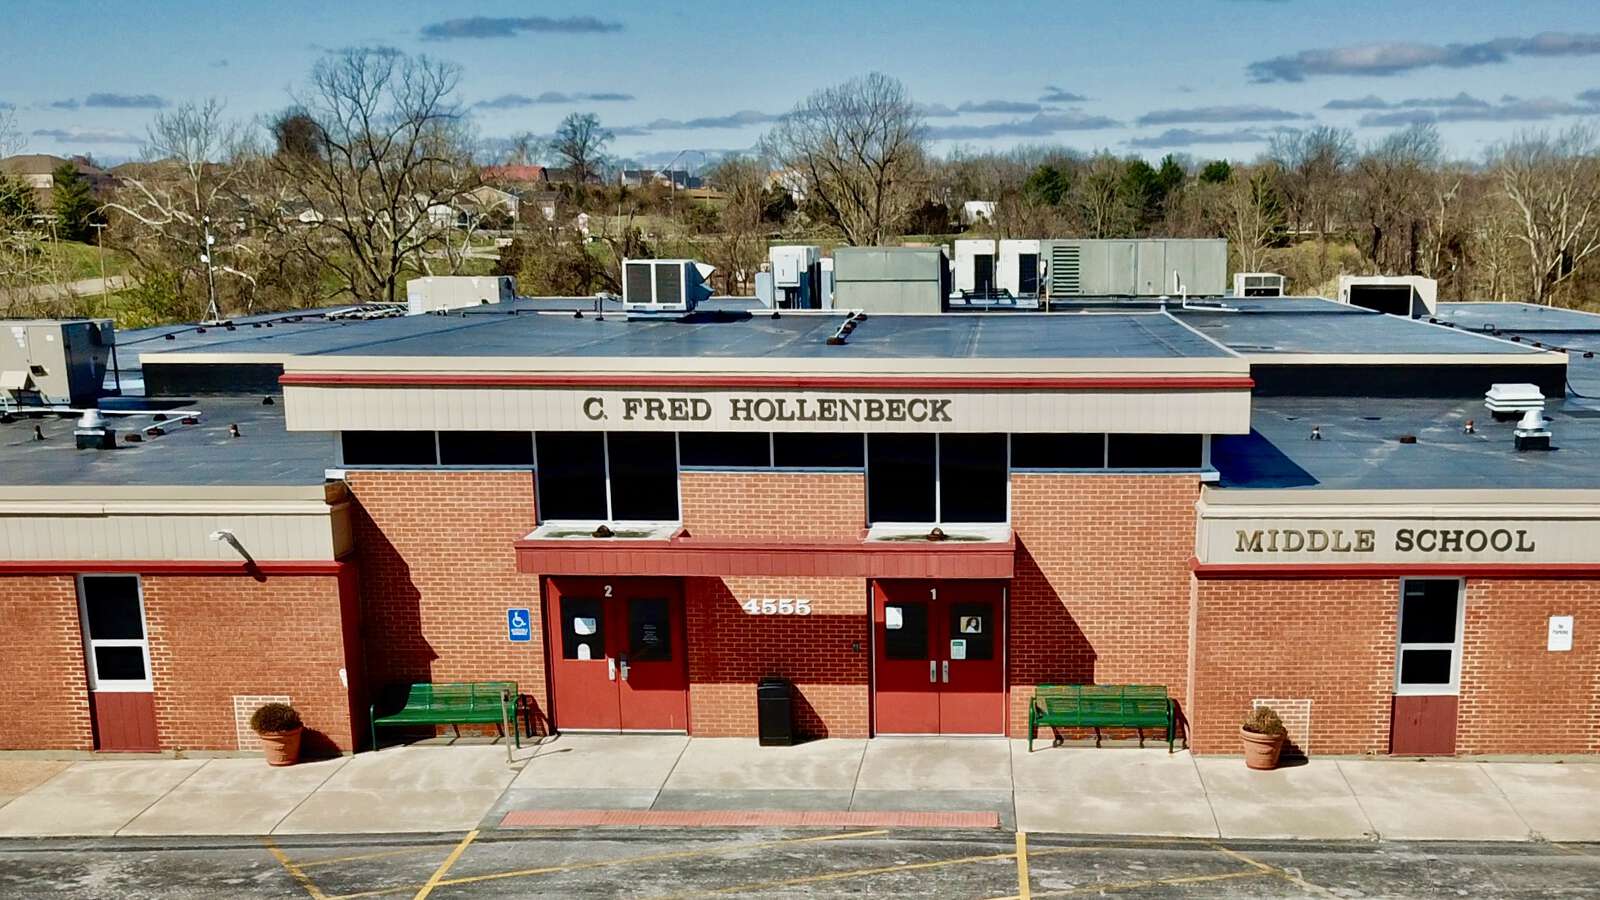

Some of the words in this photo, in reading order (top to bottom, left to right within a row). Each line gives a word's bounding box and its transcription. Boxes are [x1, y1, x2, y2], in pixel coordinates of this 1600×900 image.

[583, 397, 608, 420] C.
[622, 398, 712, 421] FRED
[729, 398, 953, 422] HOLLENBECK
[1234, 529, 1376, 553] MIDDLE
[1395, 528, 1535, 552] SCHOOL
[604, 585, 612, 597] 2
[930, 588, 937, 600] 1
[742, 599, 812, 615] 4555
